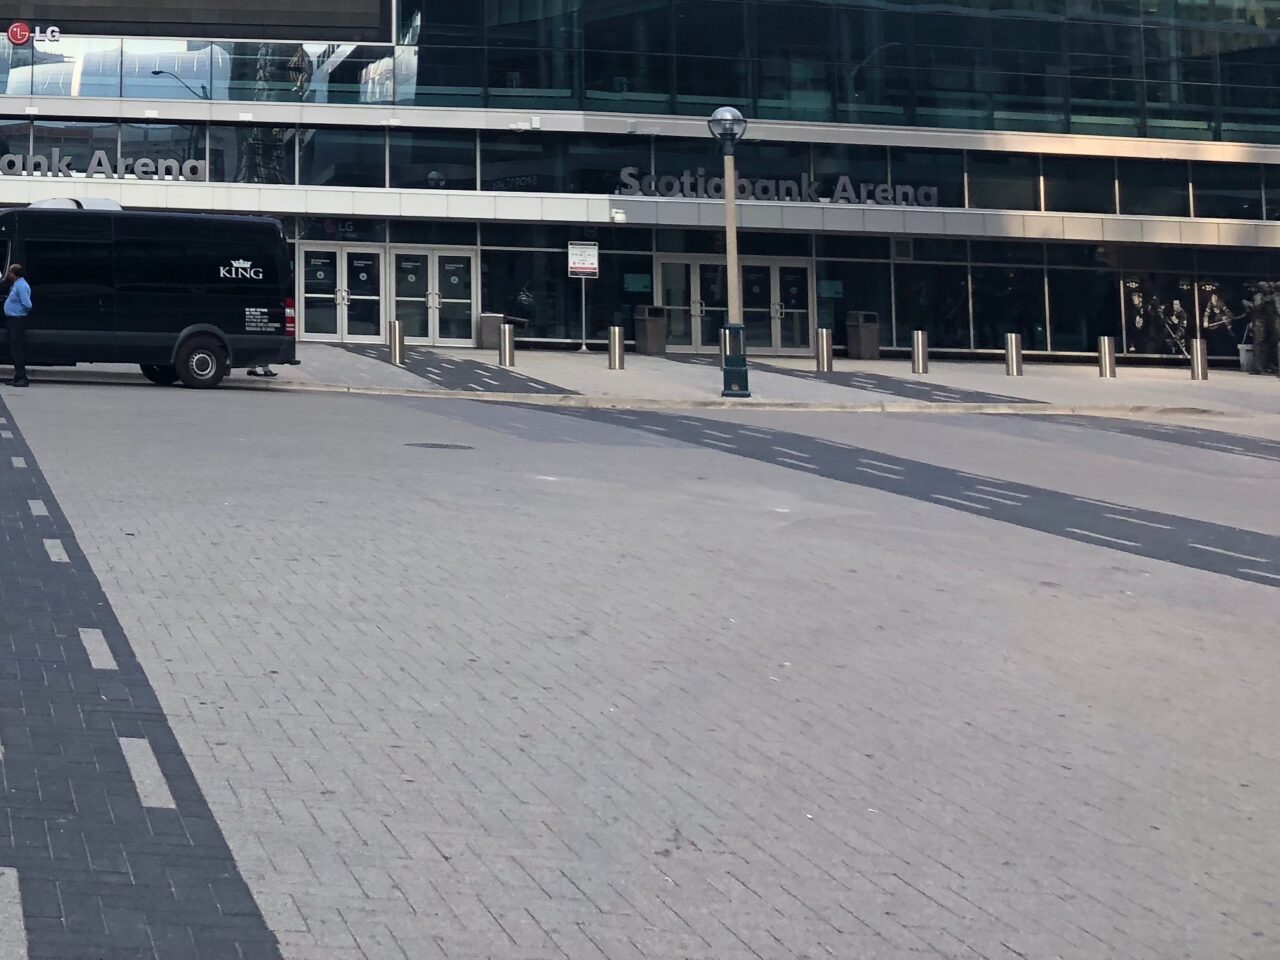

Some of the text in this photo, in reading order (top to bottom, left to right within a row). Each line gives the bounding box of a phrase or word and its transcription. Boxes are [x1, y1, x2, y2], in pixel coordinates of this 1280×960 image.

[34, 26, 60, 41] LG
[86, 150, 206, 181] Arena
[620, 166, 939, 208] Scotiabank Arena
[219, 266, 263, 279] KING
